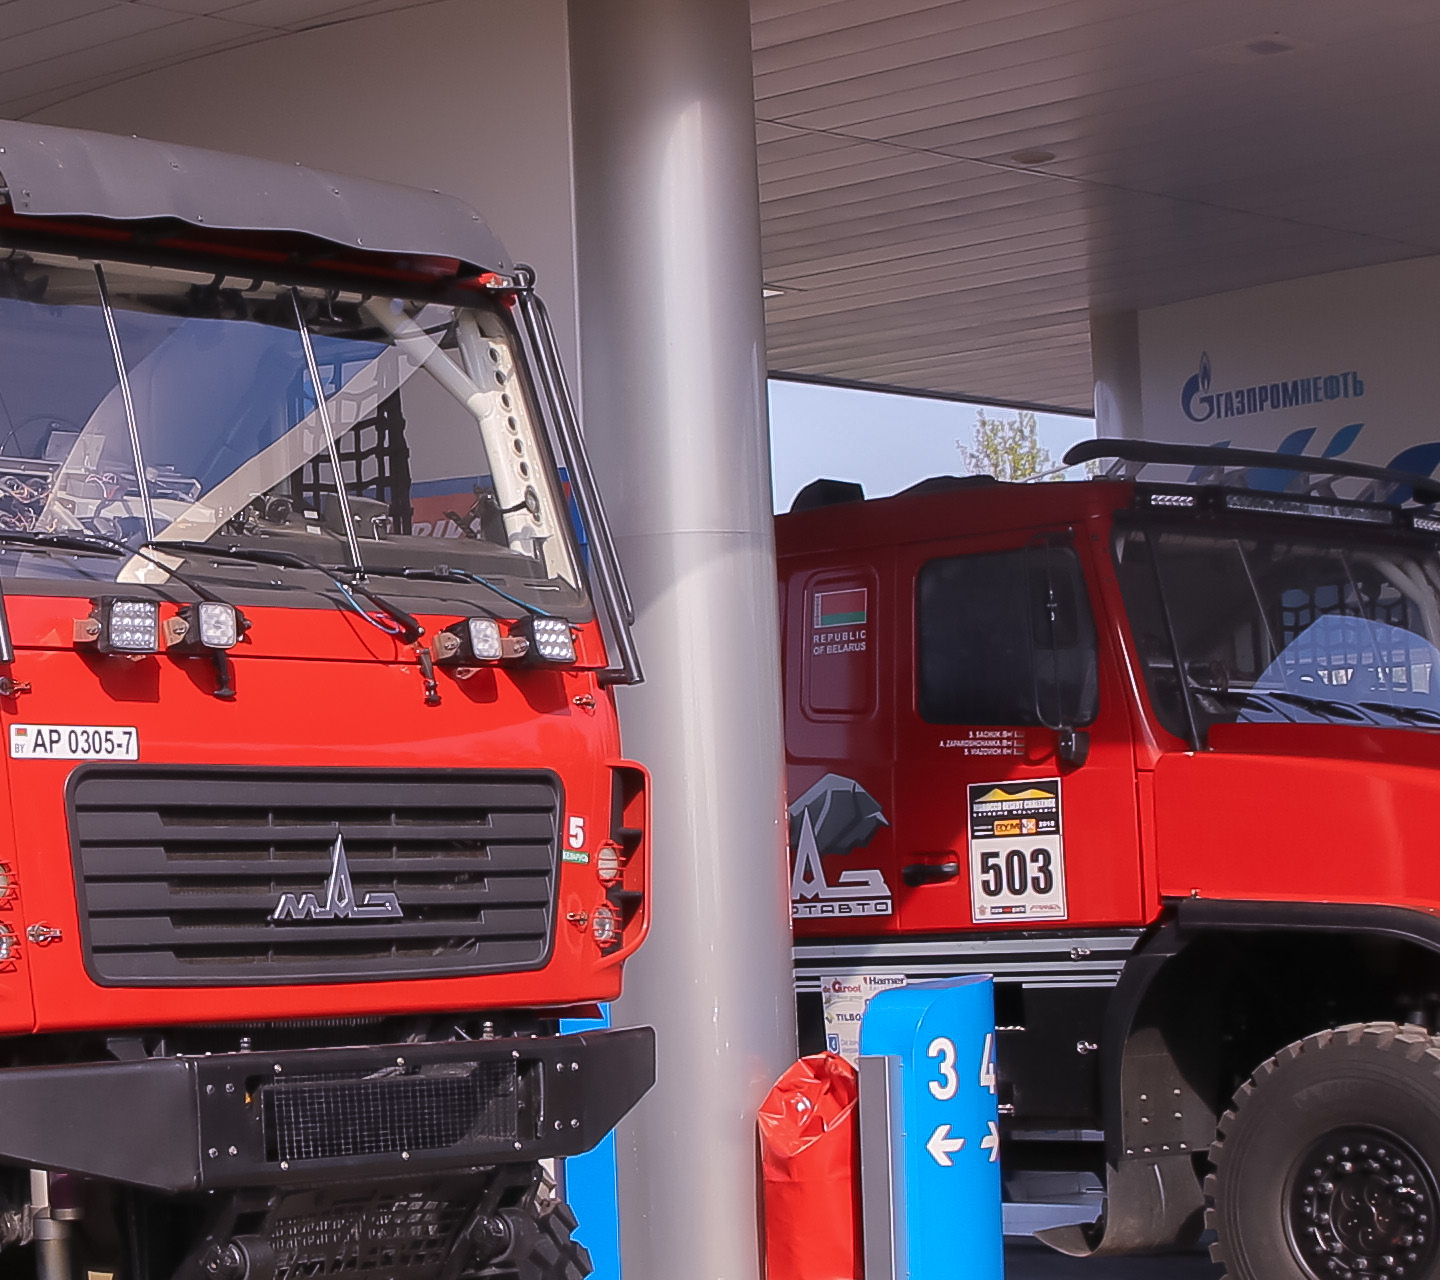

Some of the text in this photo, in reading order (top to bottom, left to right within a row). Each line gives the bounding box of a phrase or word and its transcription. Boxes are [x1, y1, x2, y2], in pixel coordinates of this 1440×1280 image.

[1216, 371, 1365, 419] ГАЗПРОМНЕФТЬ
[813, 630, 866, 643] REPUBLIC
[813, 642, 866, 655] OF BELARUS
[15, 729, 133, 754] BY AP 0305-7
[569, 816, 584, 849] 5
[980, 848, 1053, 897] 503
[792, 902, 889, 915] РТАВТО
[836, 1013, 862, 1021] TILBO
[927, 1033, 996, 1101] 3 4
